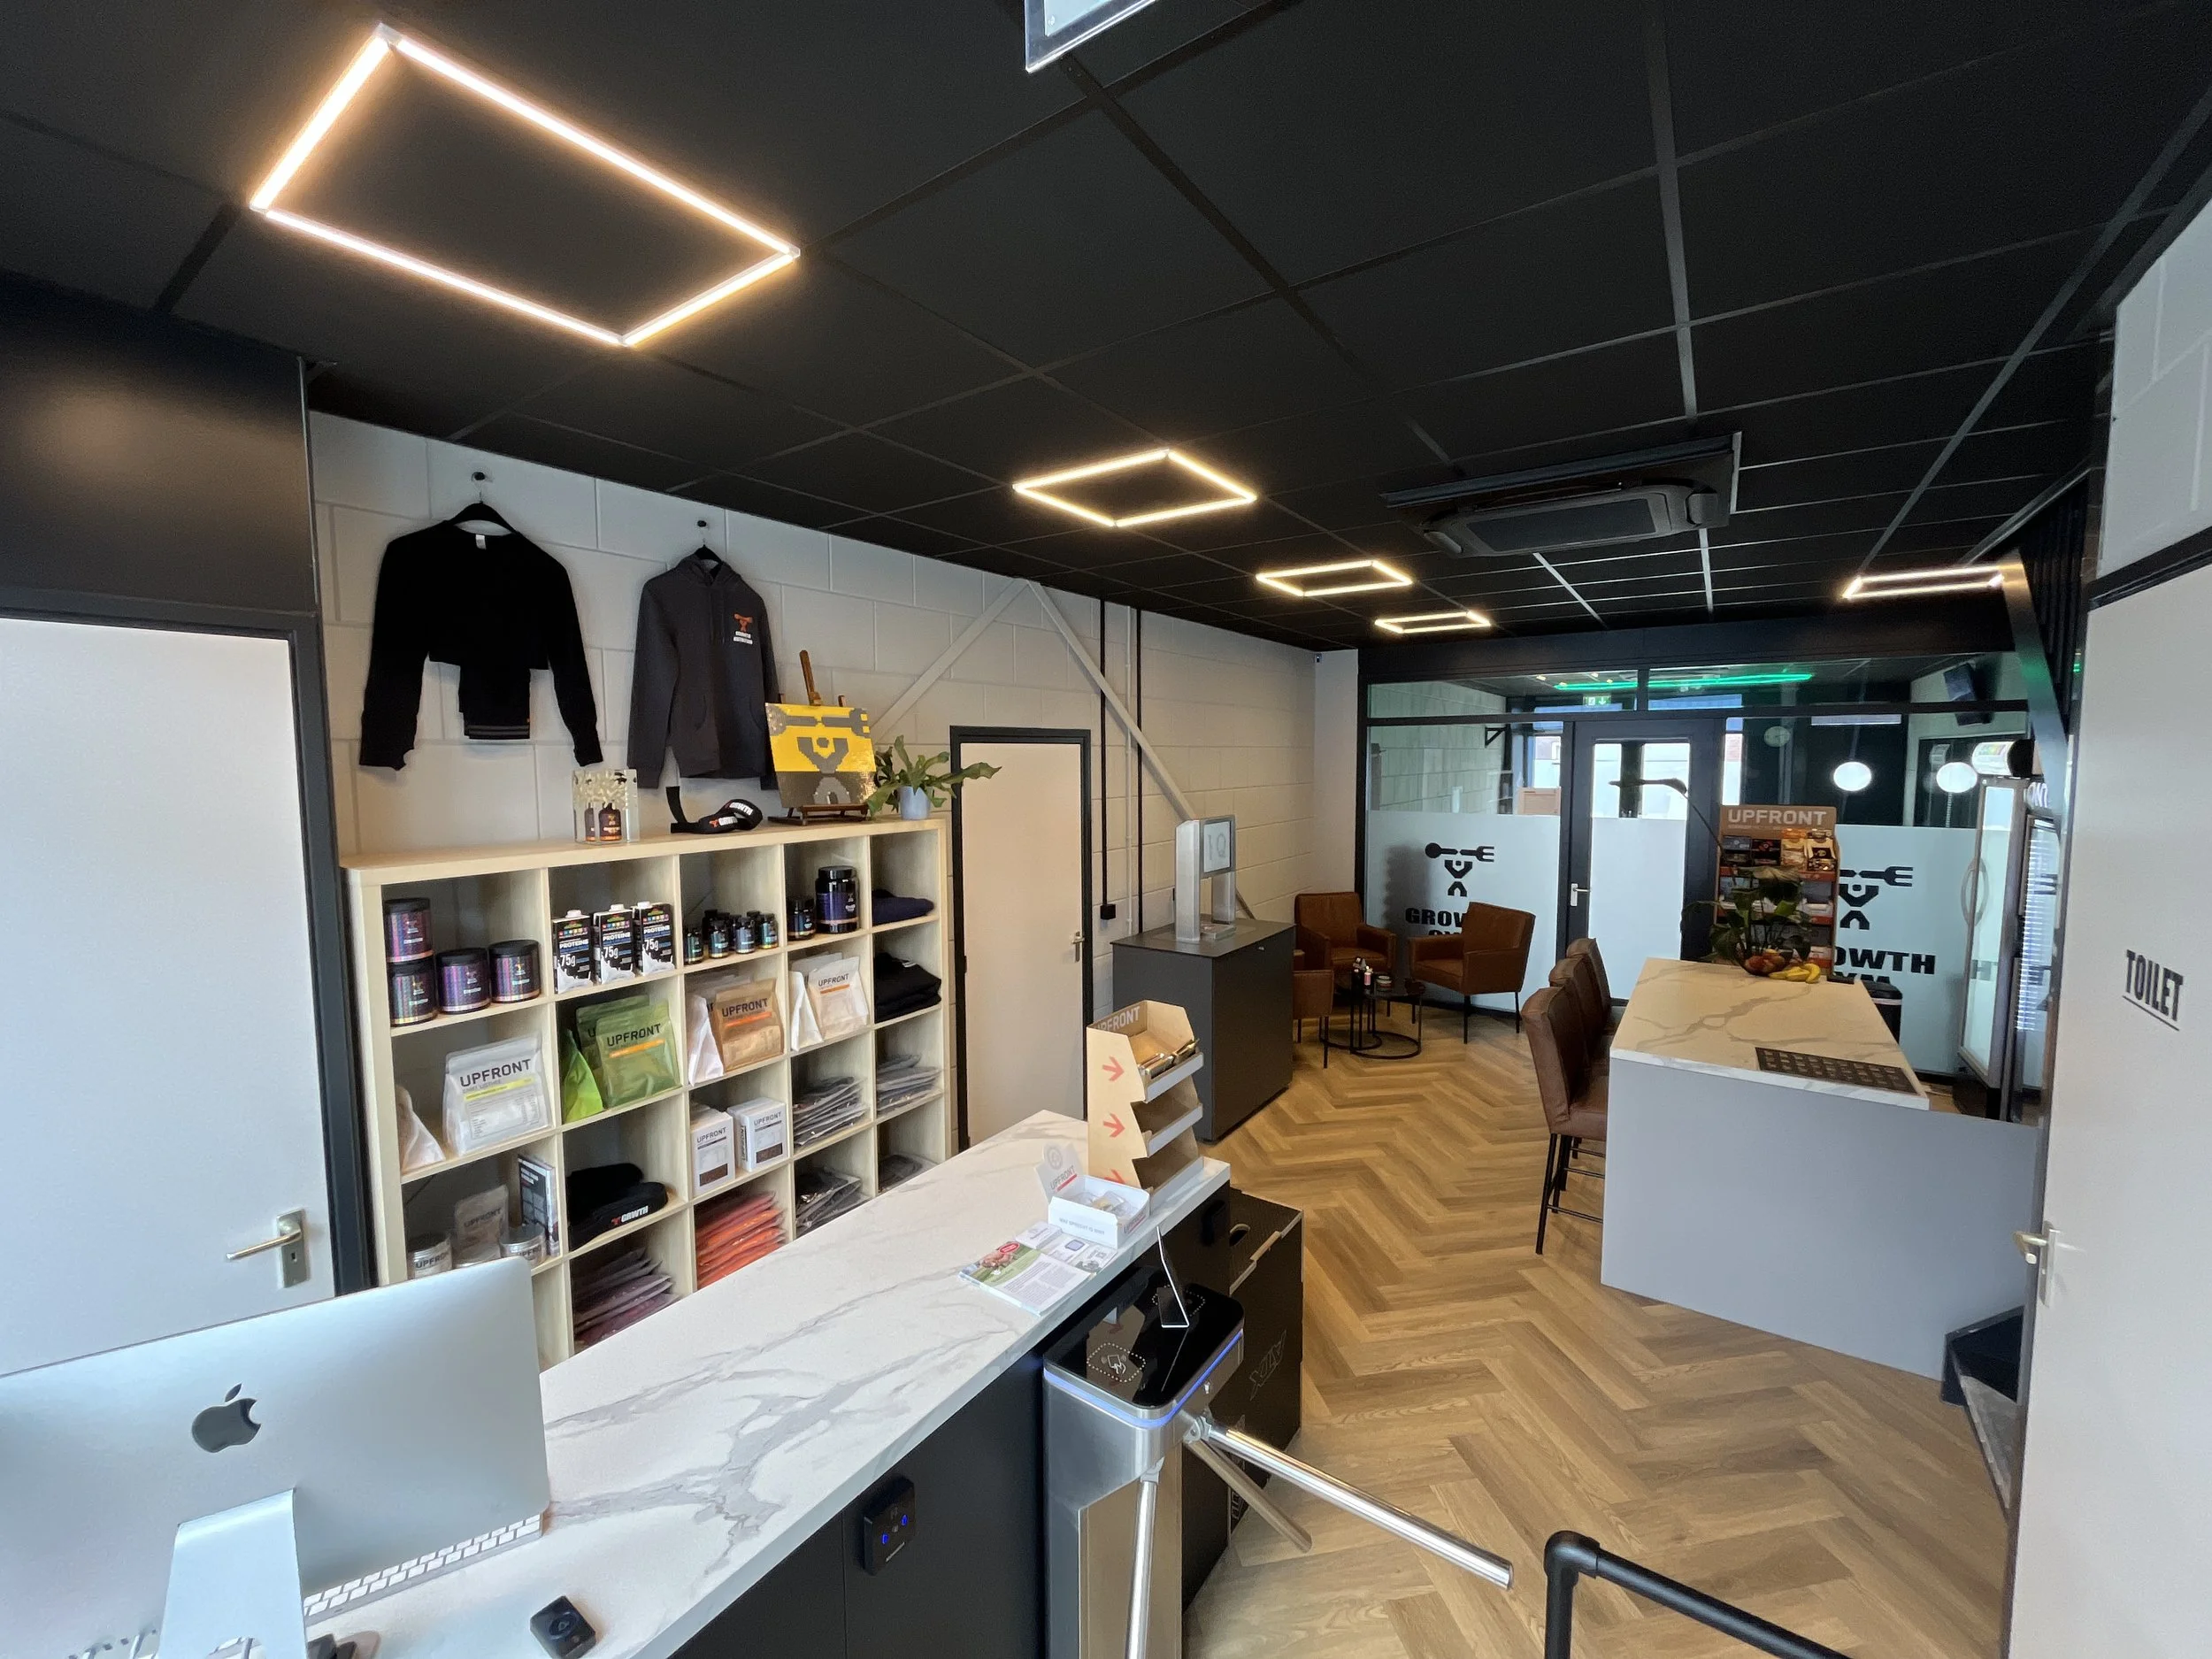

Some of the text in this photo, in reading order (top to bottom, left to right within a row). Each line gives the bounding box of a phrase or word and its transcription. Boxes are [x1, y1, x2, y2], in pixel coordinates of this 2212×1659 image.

[1727, 809, 1827, 826] UPFRONT
[1405, 908, 1463, 928] GRO
[603, 946, 618, 959] 75g
[644, 939, 659, 951] 75g
[560, 954, 576, 967] 75g
[1834, 946, 1937, 975] OWTH
[818, 973, 849, 987] UPFRONT
[2126, 949, 2184, 1022] TOILET
[722, 998, 768, 1017] UPFRONT
[1097, 1005, 1141, 1032] PFRONT
[607, 1023, 661, 1047] UPFRONT
[460, 1058, 531, 1087] UPFRONT
[753, 1111, 781, 1126] UPFRONT
[696, 1126, 726, 1143] UPFRONT
[1050, 1164, 1076, 1190] UPFRONT
